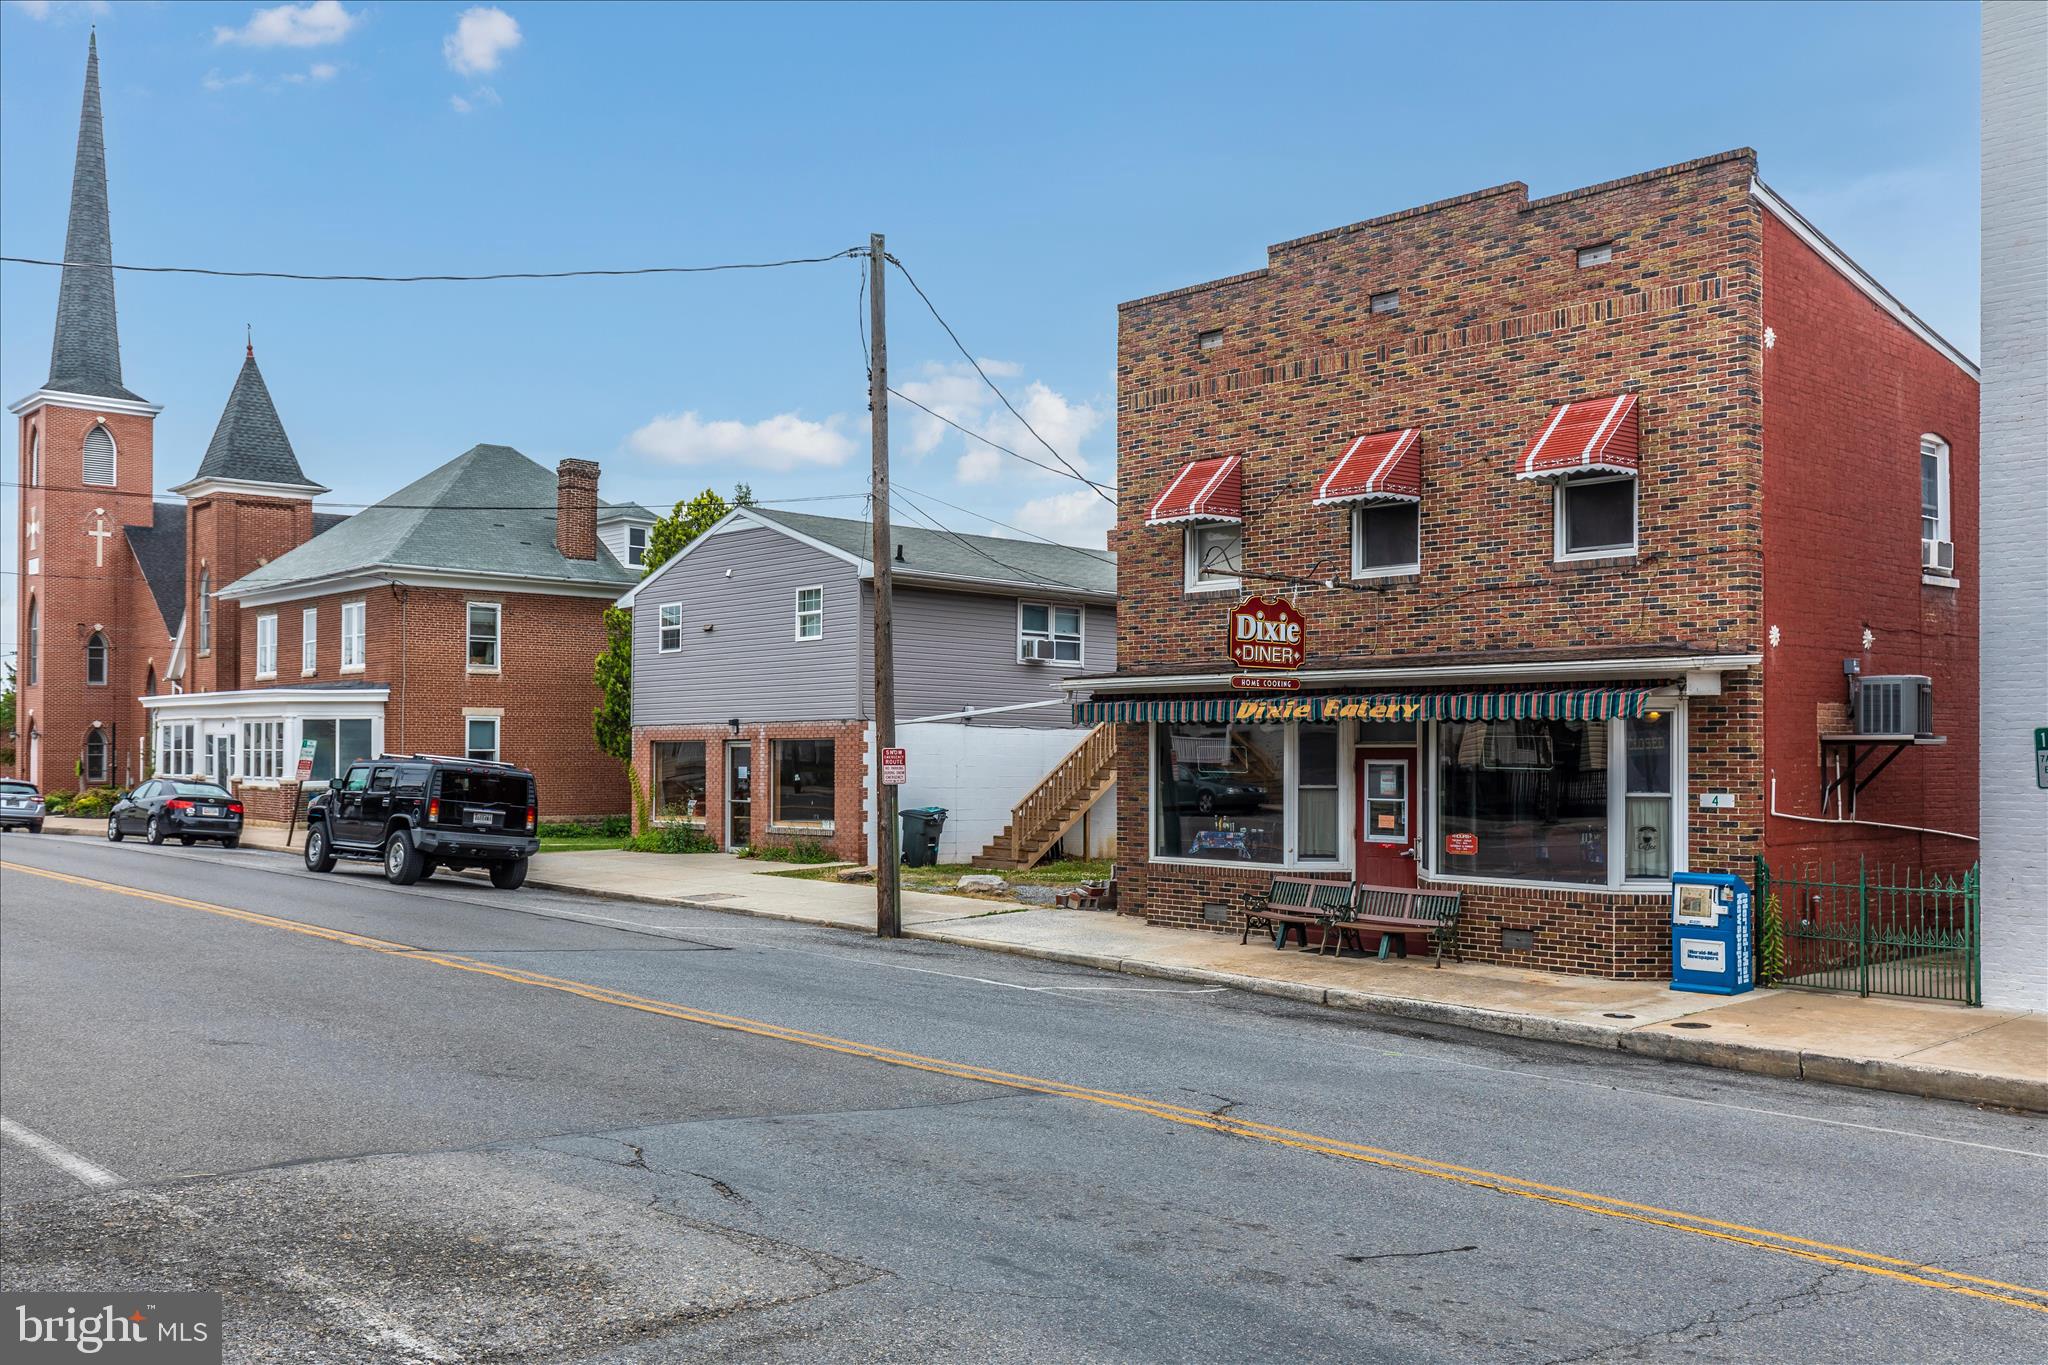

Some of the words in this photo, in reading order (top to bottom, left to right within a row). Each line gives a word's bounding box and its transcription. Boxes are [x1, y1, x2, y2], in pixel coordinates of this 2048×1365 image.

[1236, 610, 1300, 645] Dixie
[1242, 644, 1293, 663] DINER
[1241, 679, 1260, 687] HOME
[1263, 680, 1292, 688] COOKING
[1236, 700, 1311, 718] Dixie
[1323, 698, 1421, 718] Eatery
[1711, 795, 1719, 806] 4
[1687, 953, 1719, 961] Newspapers
